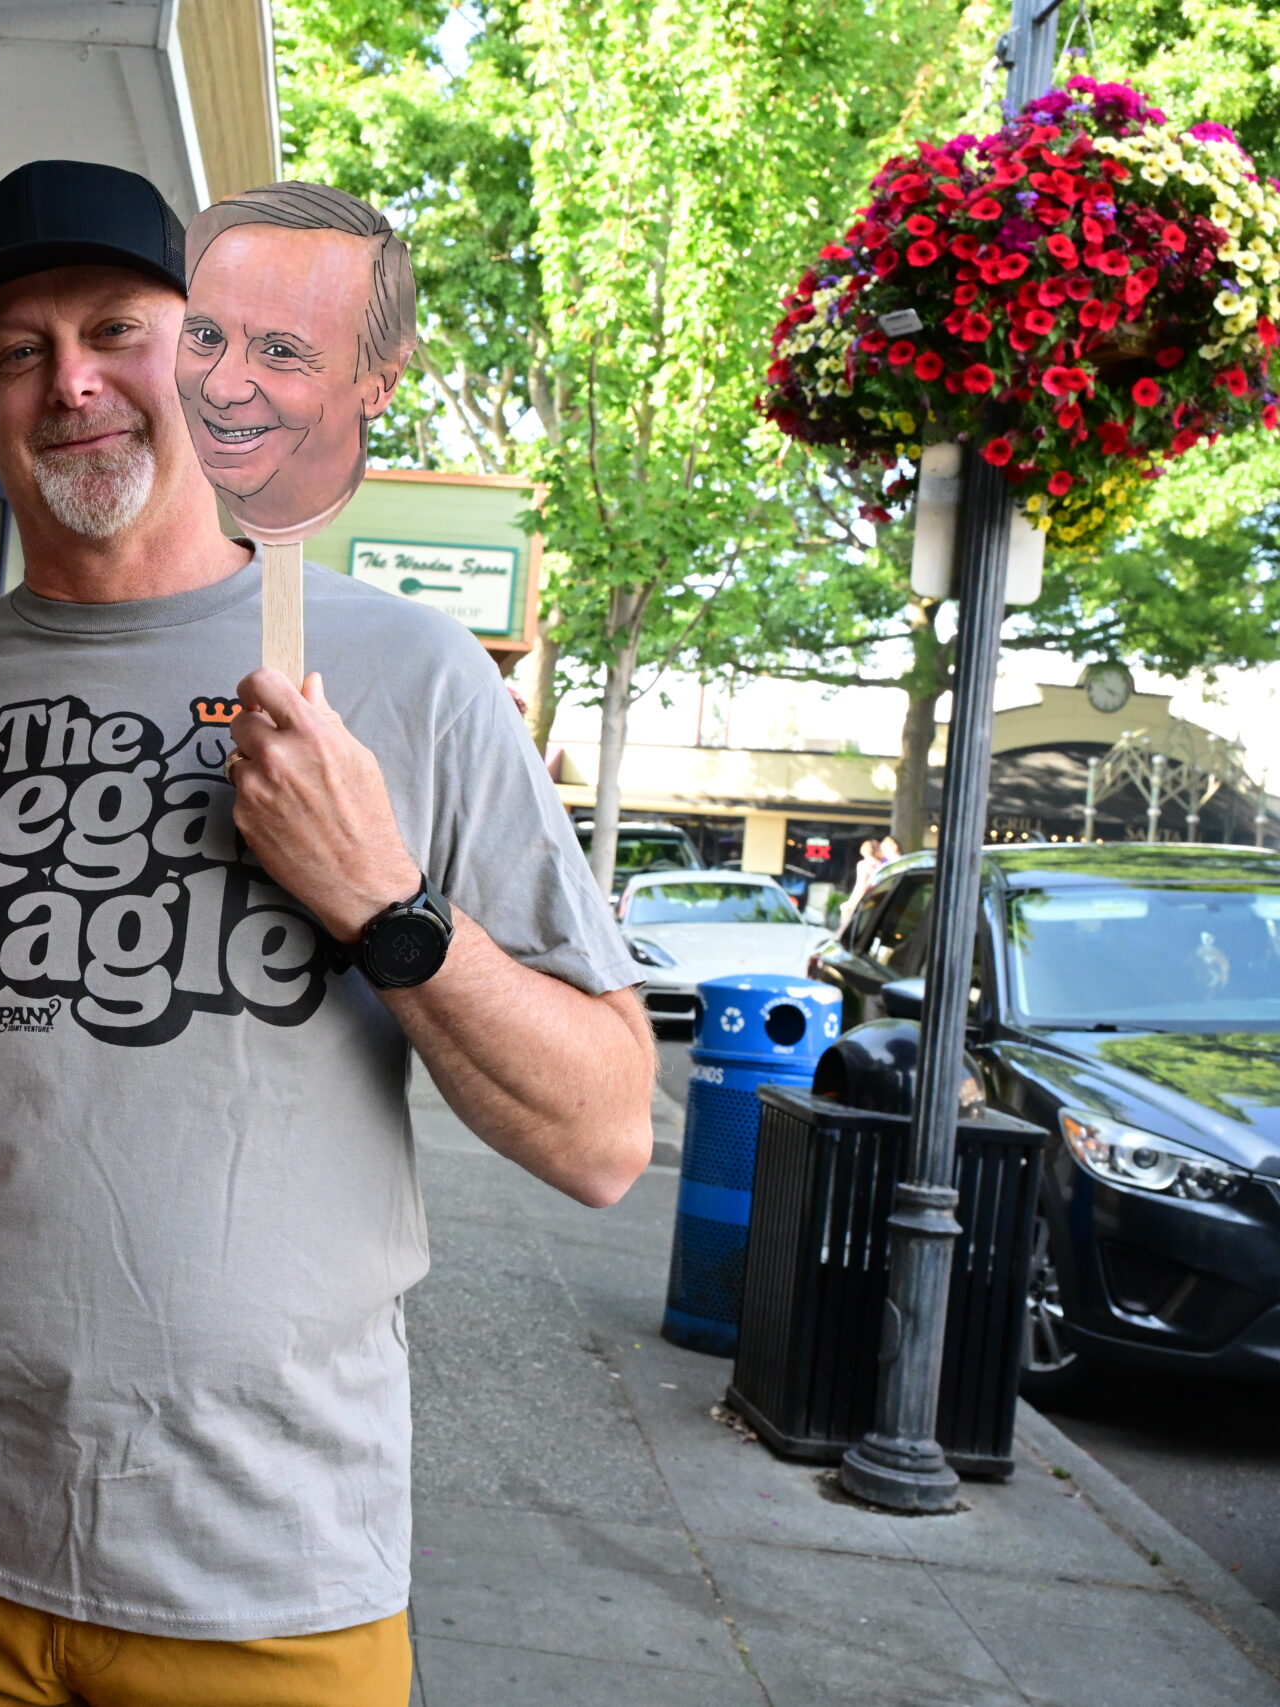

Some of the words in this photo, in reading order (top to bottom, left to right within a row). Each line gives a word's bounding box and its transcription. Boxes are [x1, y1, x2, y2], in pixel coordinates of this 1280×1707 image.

[358, 551, 387, 570] The
[394, 554, 453, 573] Wooden
[459, 558, 508, 579] Spoon
